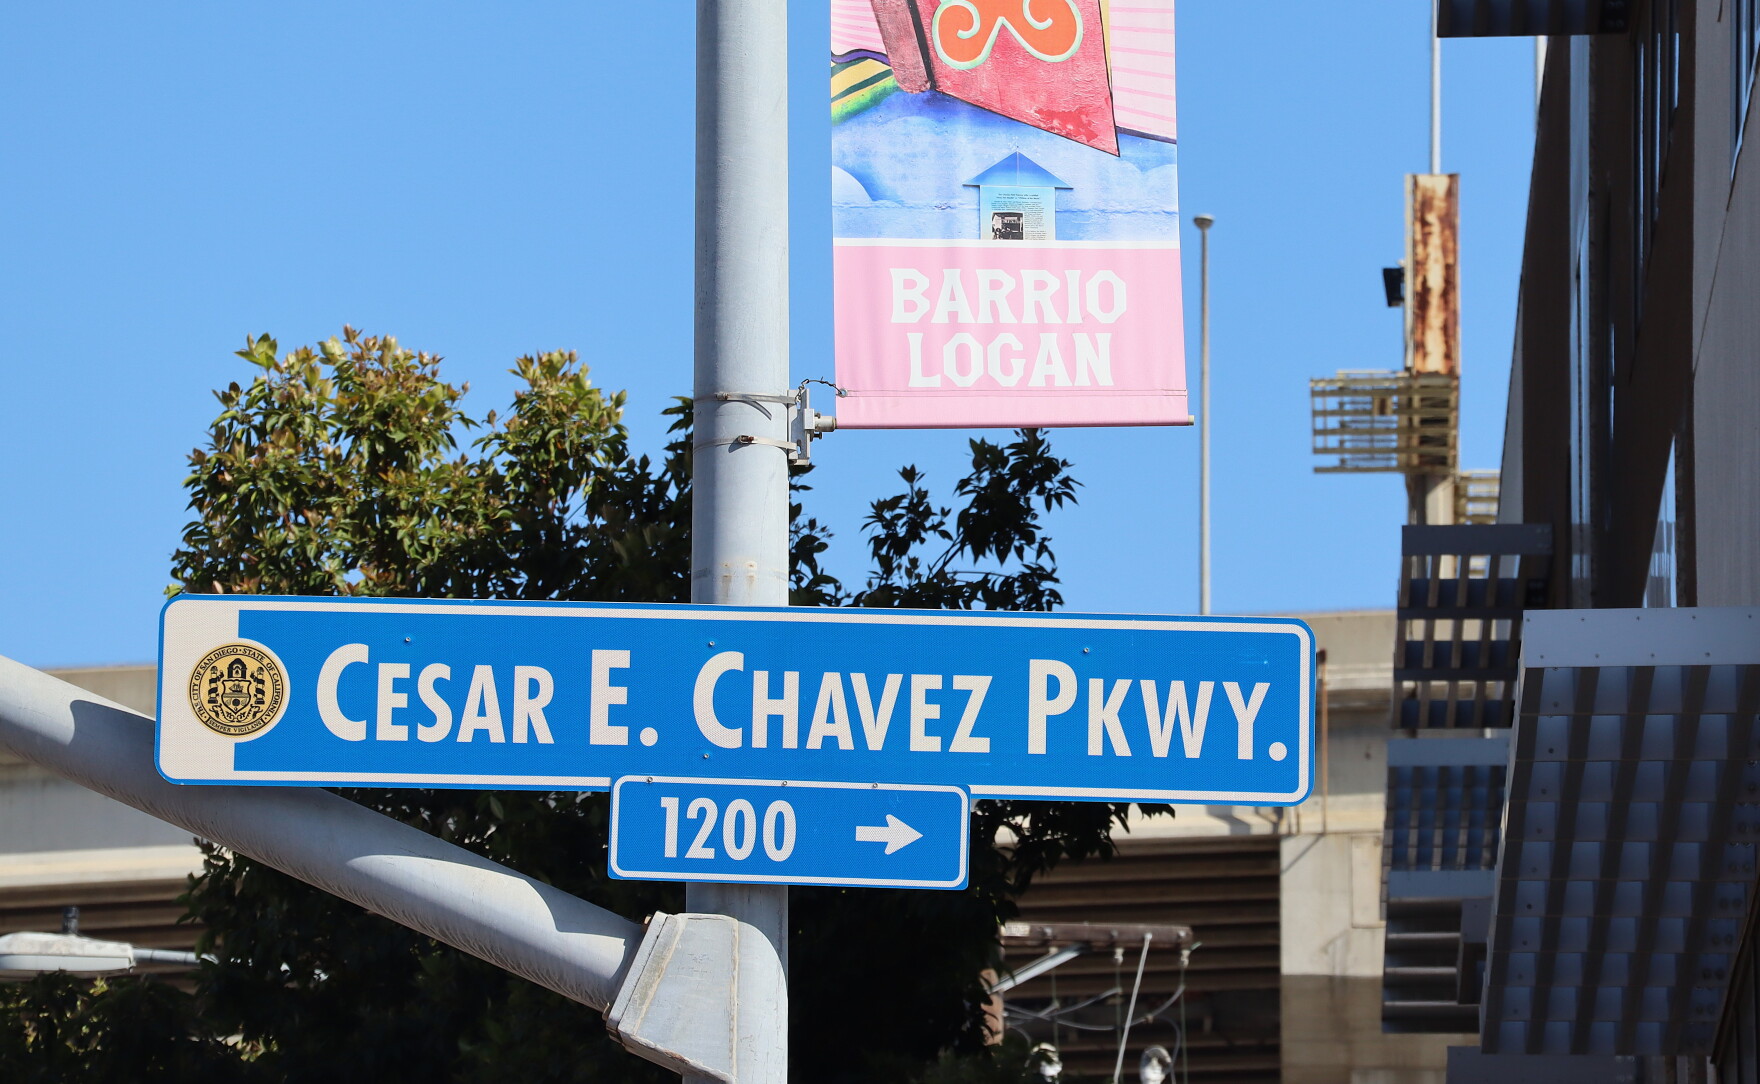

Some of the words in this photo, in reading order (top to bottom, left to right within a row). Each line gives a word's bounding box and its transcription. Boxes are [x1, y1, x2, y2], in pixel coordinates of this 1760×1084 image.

[889, 267, 1127, 324] BARRIO
[906, 332, 1114, 388] LOGAN
[213, 647, 239, 659] DIEGO
[242, 647, 266, 661] STATE
[200, 657, 214, 670] SAN
[265, 662, 276, 673] OF
[194, 671, 202, 681] OF
[192, 682, 200, 701] CITY
[264, 672, 281, 718] CALIFORNIA
[317, 643, 554, 745] CESAR
[589, 649, 658, 747] E.
[692, 650, 993, 754] CHAVEZ
[208, 720, 232, 733] SEMPER
[660, 796, 797, 862] 1200
